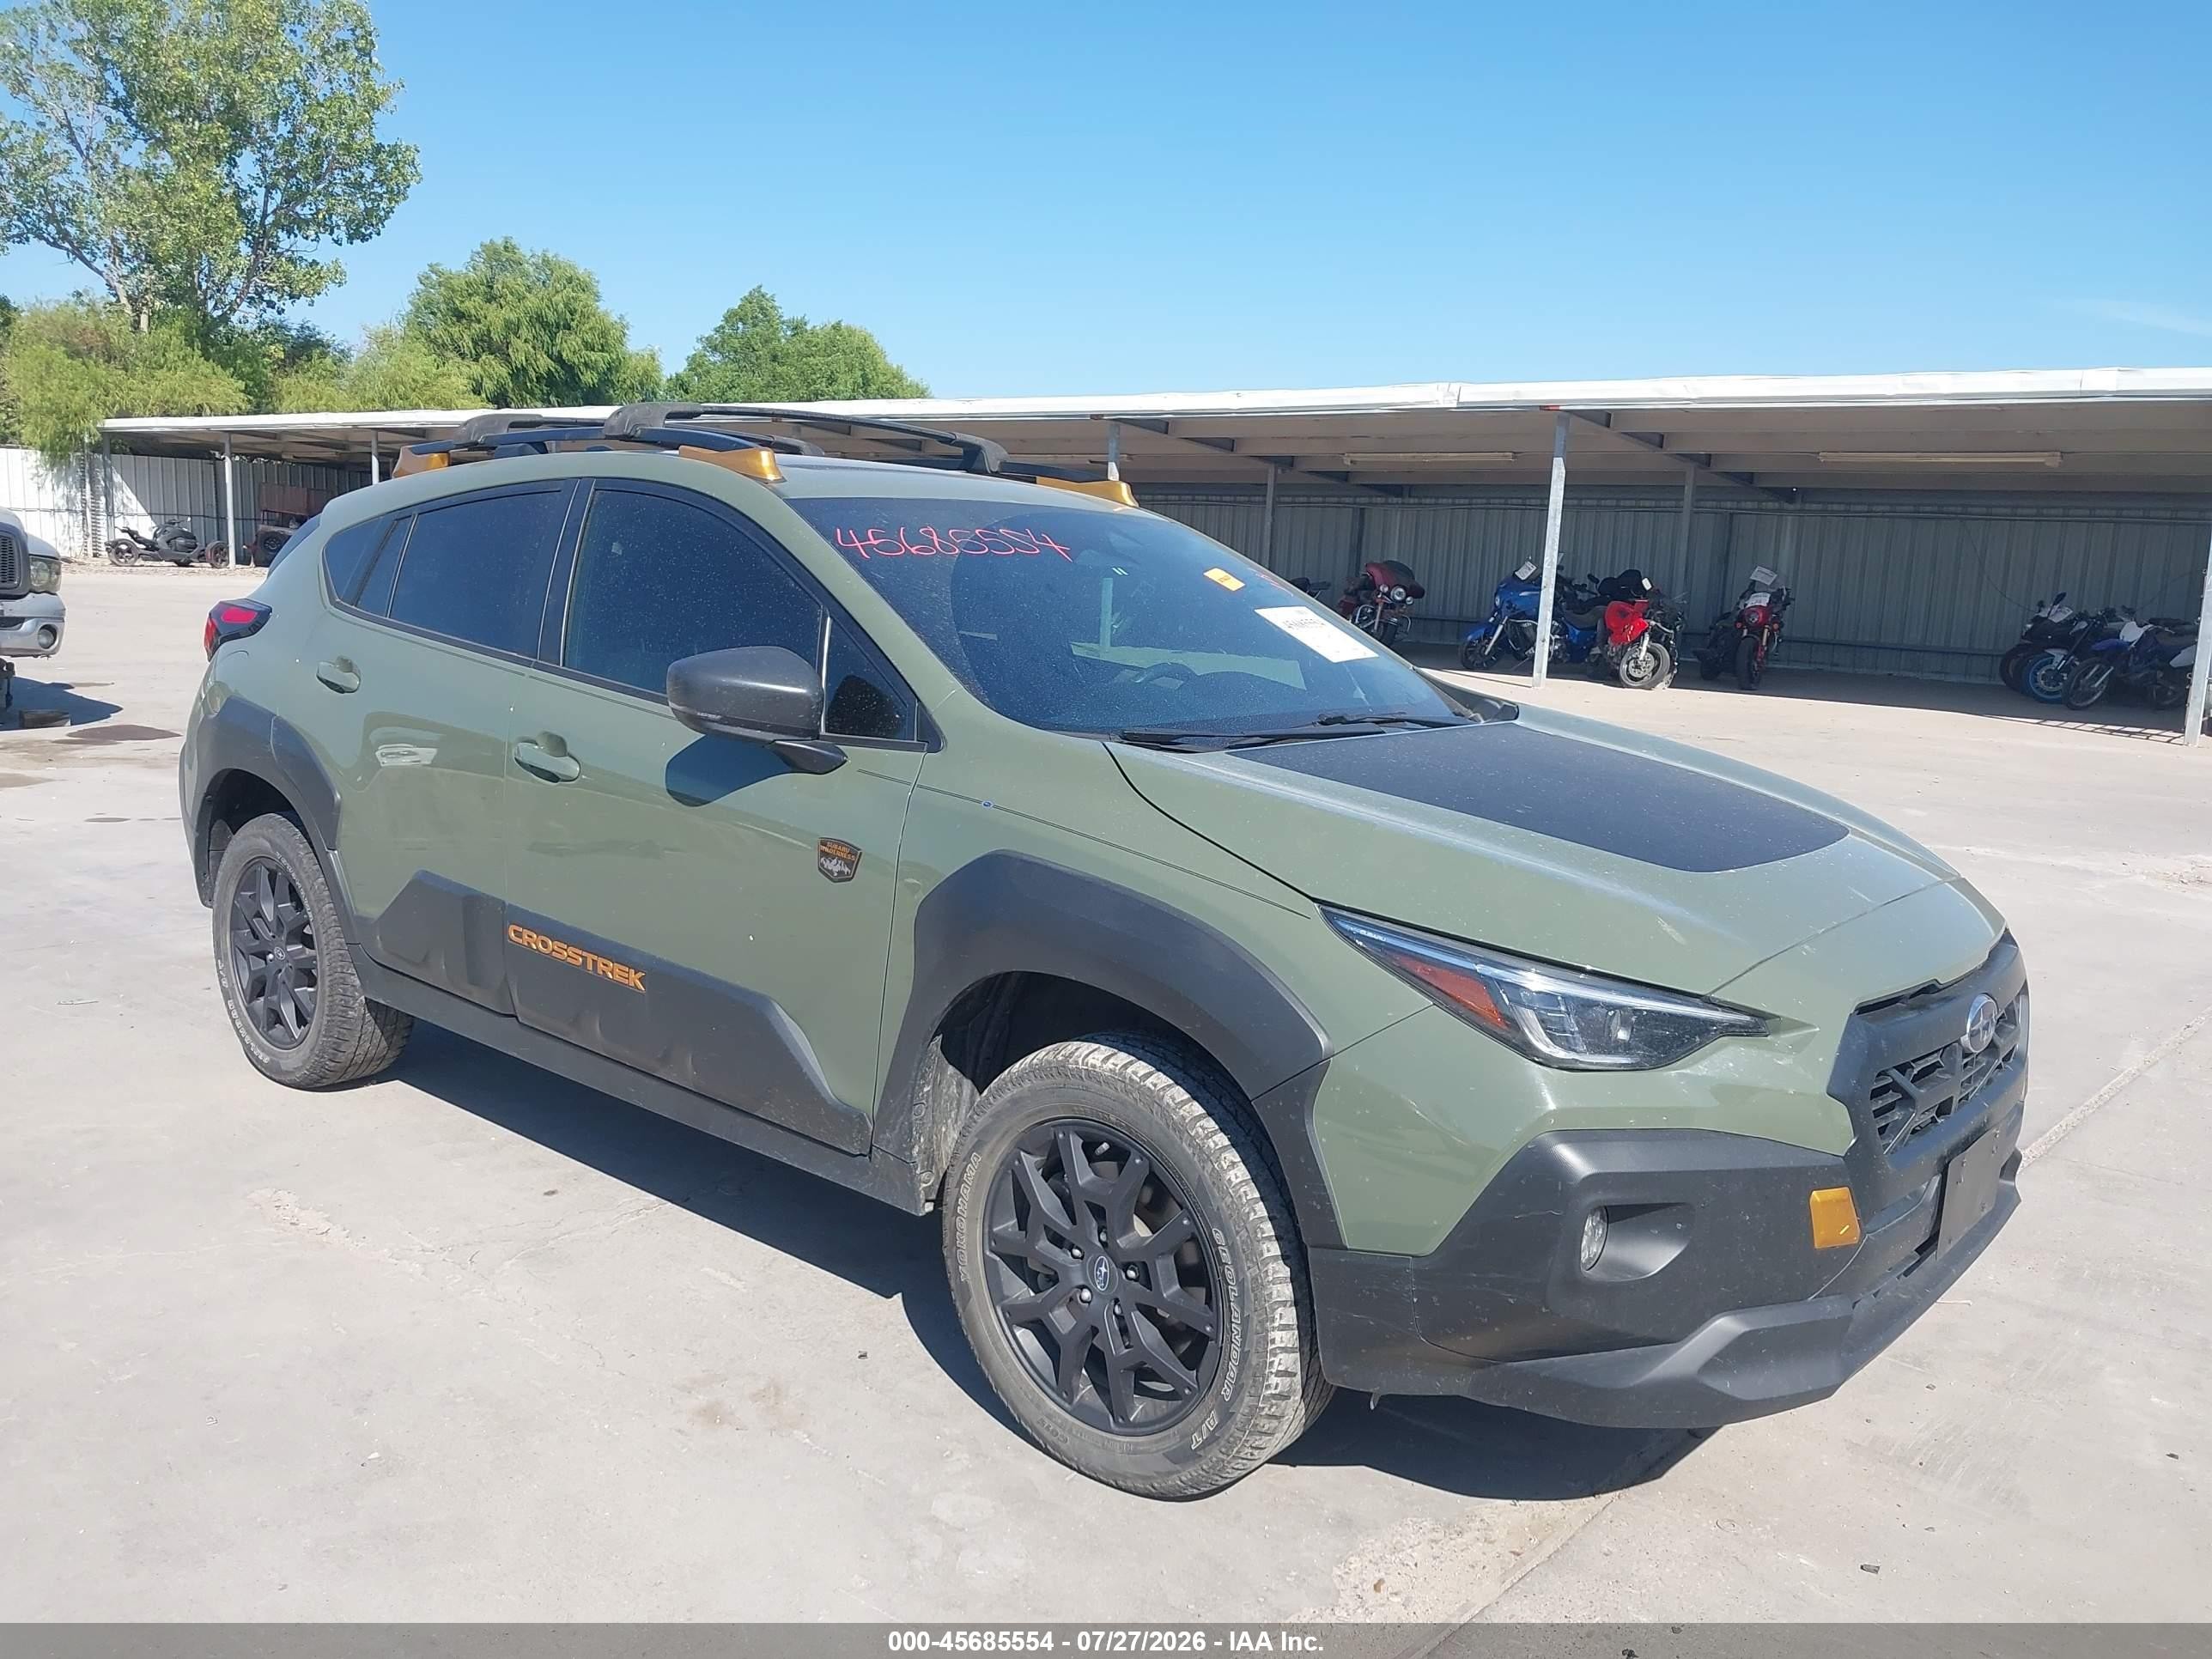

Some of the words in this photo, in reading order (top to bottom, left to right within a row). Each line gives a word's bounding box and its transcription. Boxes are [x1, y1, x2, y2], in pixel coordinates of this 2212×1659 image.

[836, 526, 1073, 562] 45685554
[820, 845, 855, 860] WILDERNESS
[826, 842, 850, 853] SUBARU
[507, 924, 646, 992] CROSSTREK
[954, 1152, 981, 1283] YOKOHAMA
[1212, 1228, 1242, 1402] GEOLANDAR
[1190, 1411, 1218, 1450] A/T
